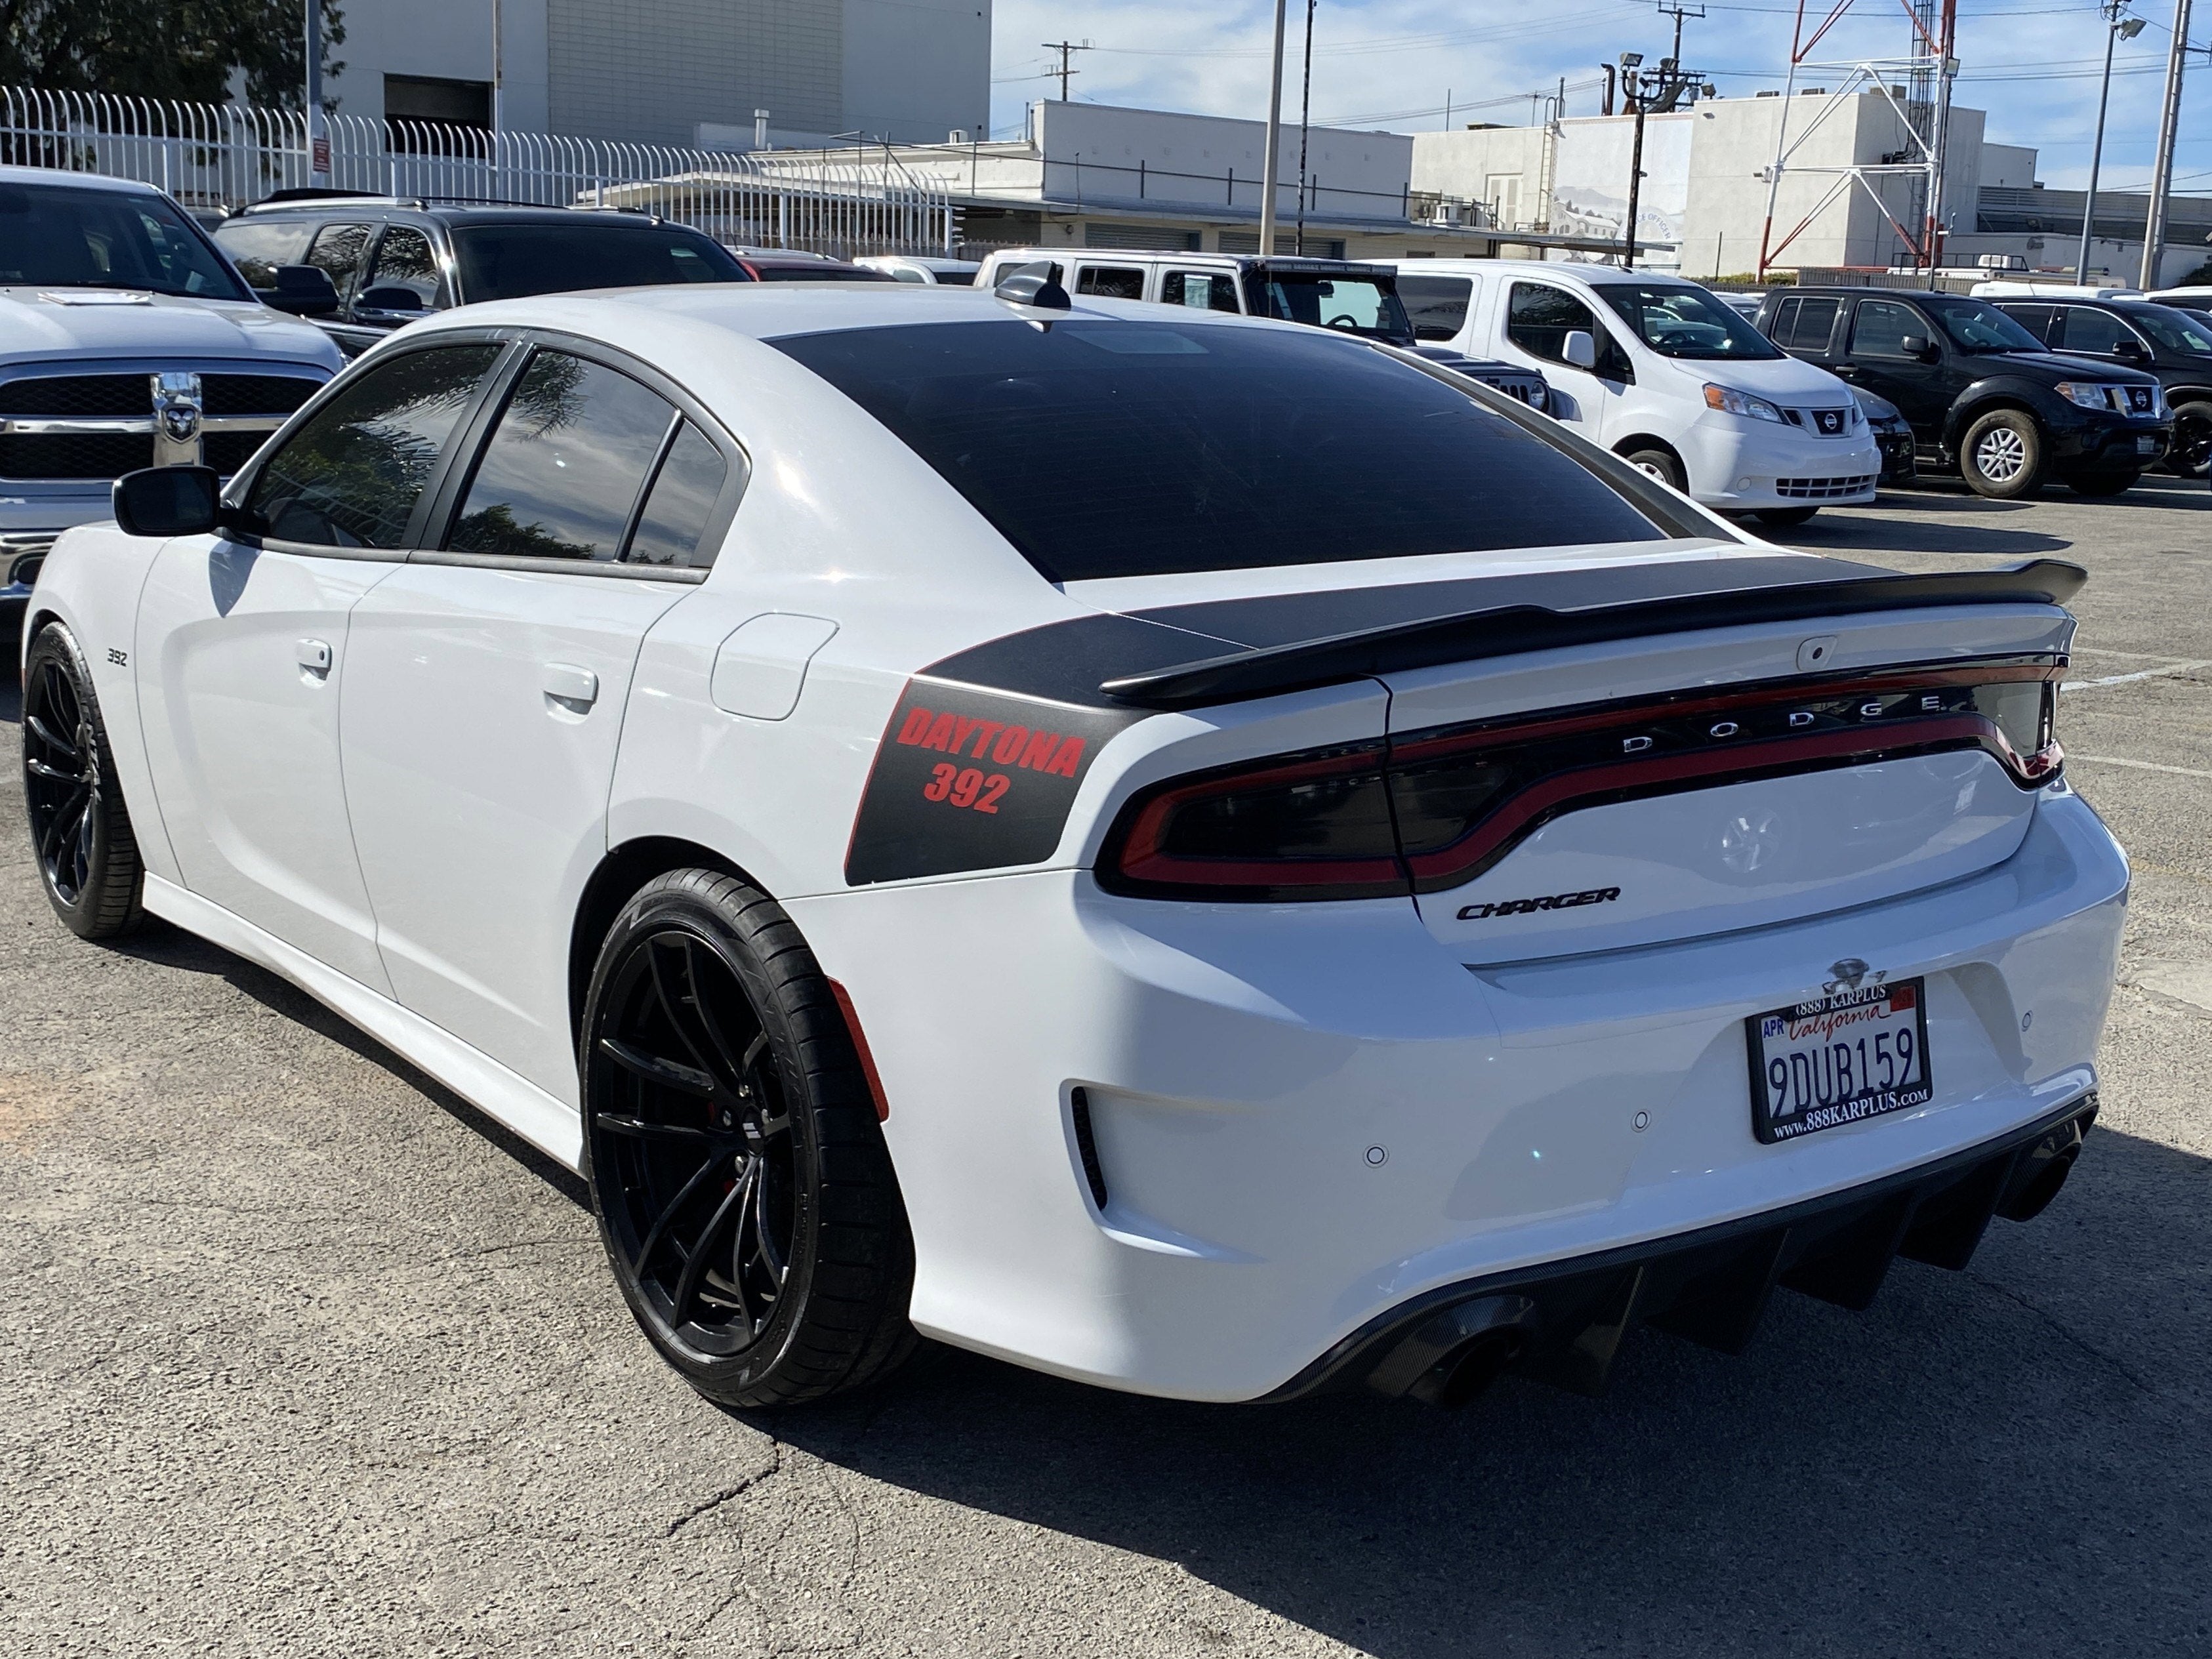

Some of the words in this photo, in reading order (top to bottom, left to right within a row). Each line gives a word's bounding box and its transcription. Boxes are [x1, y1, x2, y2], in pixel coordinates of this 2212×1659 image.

[1648, 213, 1671, 239] OFFICER
[107, 648, 127, 667] 392
[1624, 696, 1940, 752] DODGE
[897, 707, 1086, 778] DAYTONA
[923, 762, 1011, 814] 392
[1456, 887, 1621, 920] CHARGER
[1795, 998, 1826, 1016] (888)
[1830, 985, 1887, 1008] KARPLUS
[1763, 1019, 1784, 1038] APR
[1789, 1004, 1892, 1042] California
[1769, 1027, 1914, 1118] 9DUB159
